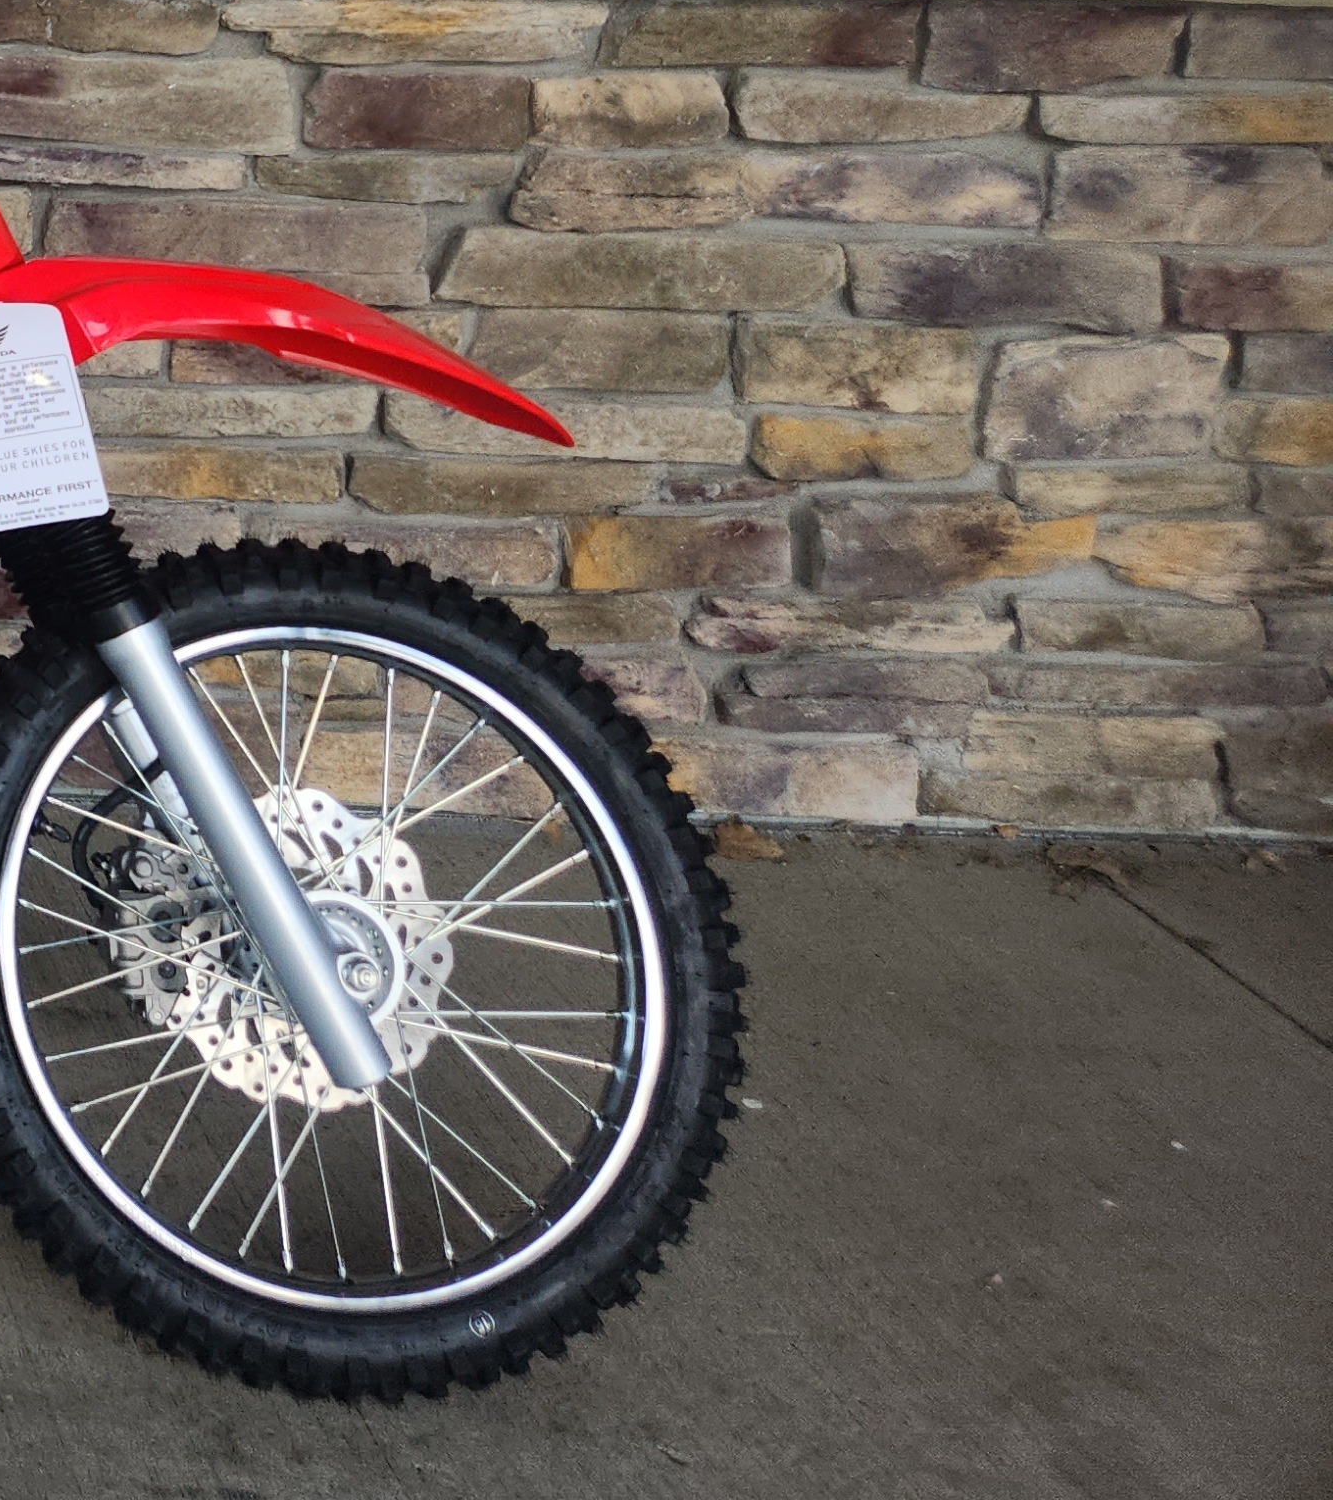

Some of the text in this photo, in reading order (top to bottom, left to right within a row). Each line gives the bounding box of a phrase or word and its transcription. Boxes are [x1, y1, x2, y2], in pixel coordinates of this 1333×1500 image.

[22, 442, 59, 456] SKIES
[62, 438, 86, 450] FOR
[21, 450, 90, 470] CHILDREN
